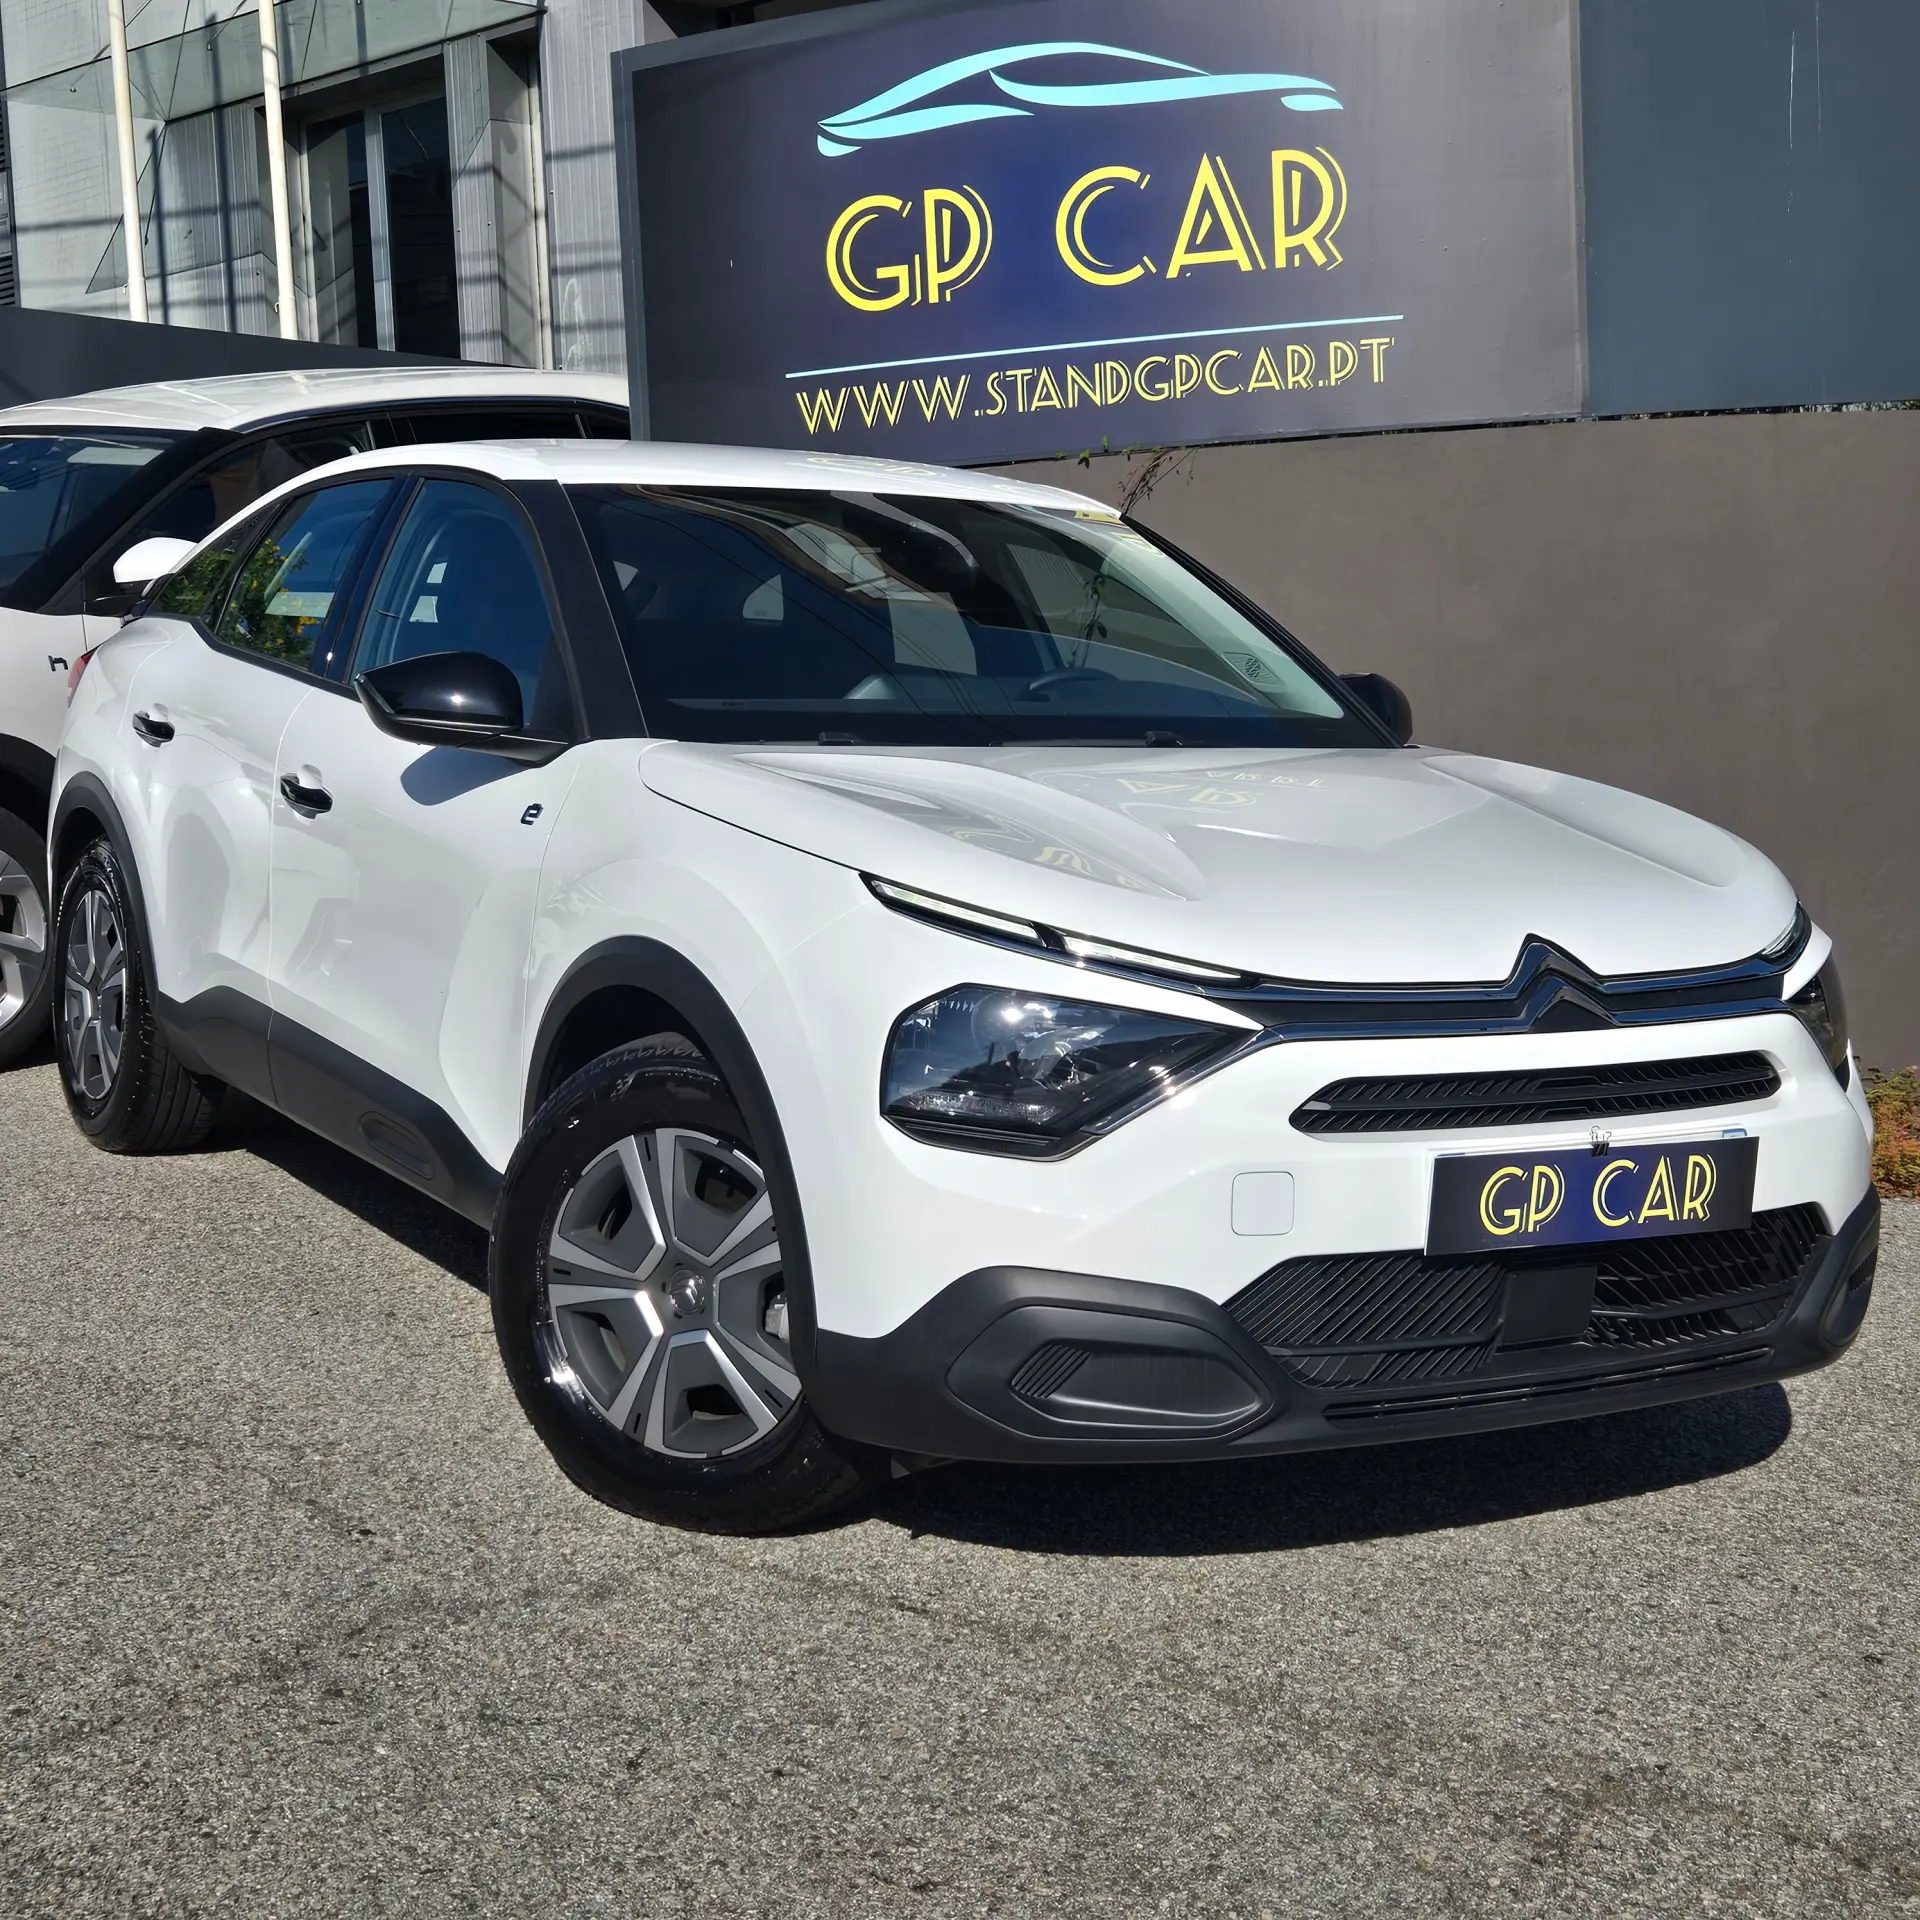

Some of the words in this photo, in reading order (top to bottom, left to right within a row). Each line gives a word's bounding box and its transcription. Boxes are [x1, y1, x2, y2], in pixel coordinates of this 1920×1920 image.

[826, 185, 992, 312] GP
[1056, 146, 1347, 286] CAR
[797, 338, 1394, 434] WWW.STANDGPCAR.PT
[1479, 1164, 1565, 1236] GP
[1592, 1154, 1718, 1227] CAR
